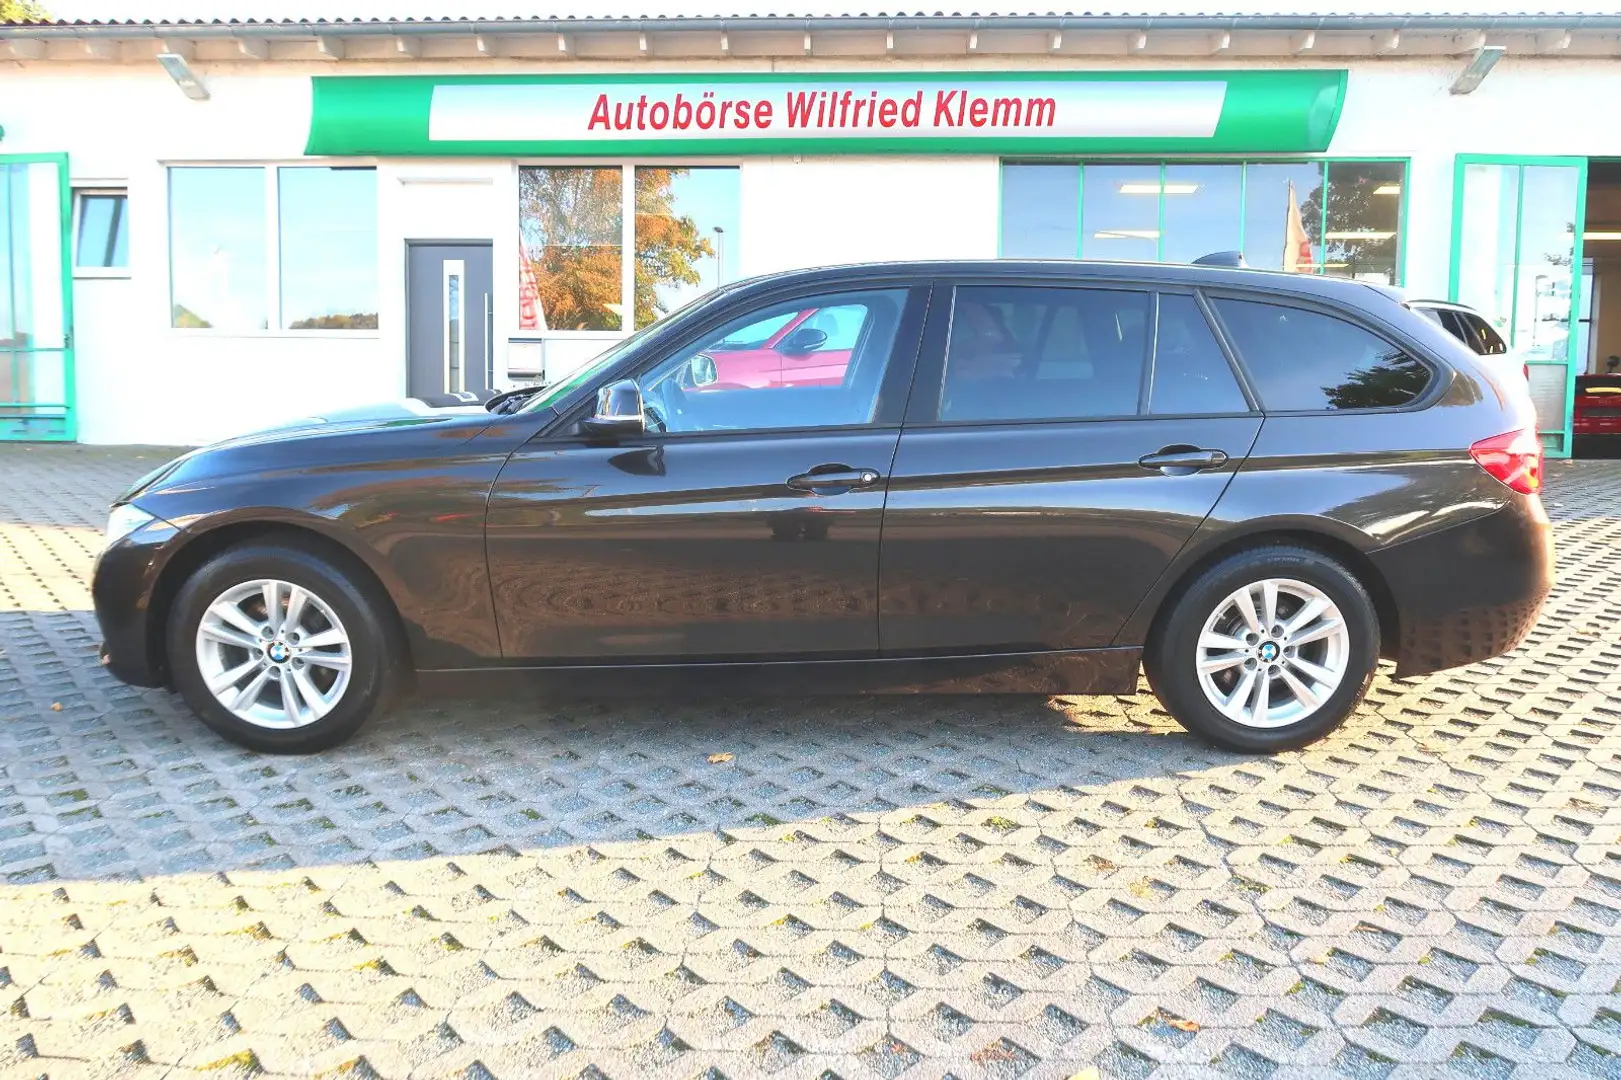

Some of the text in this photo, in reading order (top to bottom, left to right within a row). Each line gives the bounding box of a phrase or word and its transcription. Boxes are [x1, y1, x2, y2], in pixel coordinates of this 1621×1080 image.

[587, 89, 1056, 131] Autobörse Wilfried Klemm
